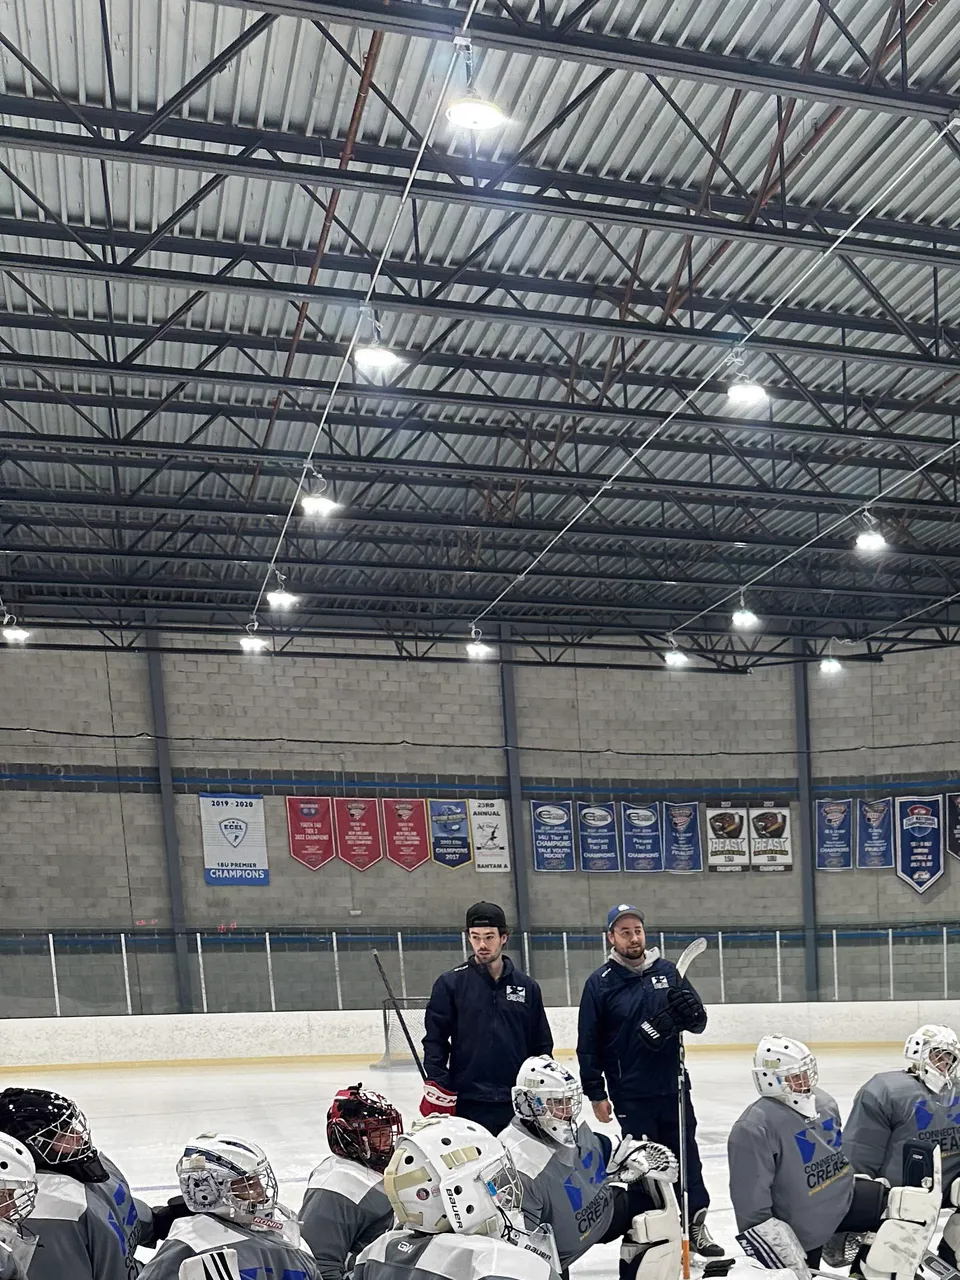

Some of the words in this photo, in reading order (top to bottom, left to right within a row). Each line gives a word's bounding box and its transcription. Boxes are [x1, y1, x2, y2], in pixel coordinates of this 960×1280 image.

[712, 838, 743, 851] BEAST
[754, 838, 785, 851] BEAST
[210, 869, 264, 878] CHAMPIONS
[806, 1160, 849, 1189] CREAS
[445, 1187, 464, 1229] BAUER
[578, 1196, 611, 1234] CREA
[254, 1217, 284, 1230] RONIN
[524, 1243, 552, 1260] BAUER
